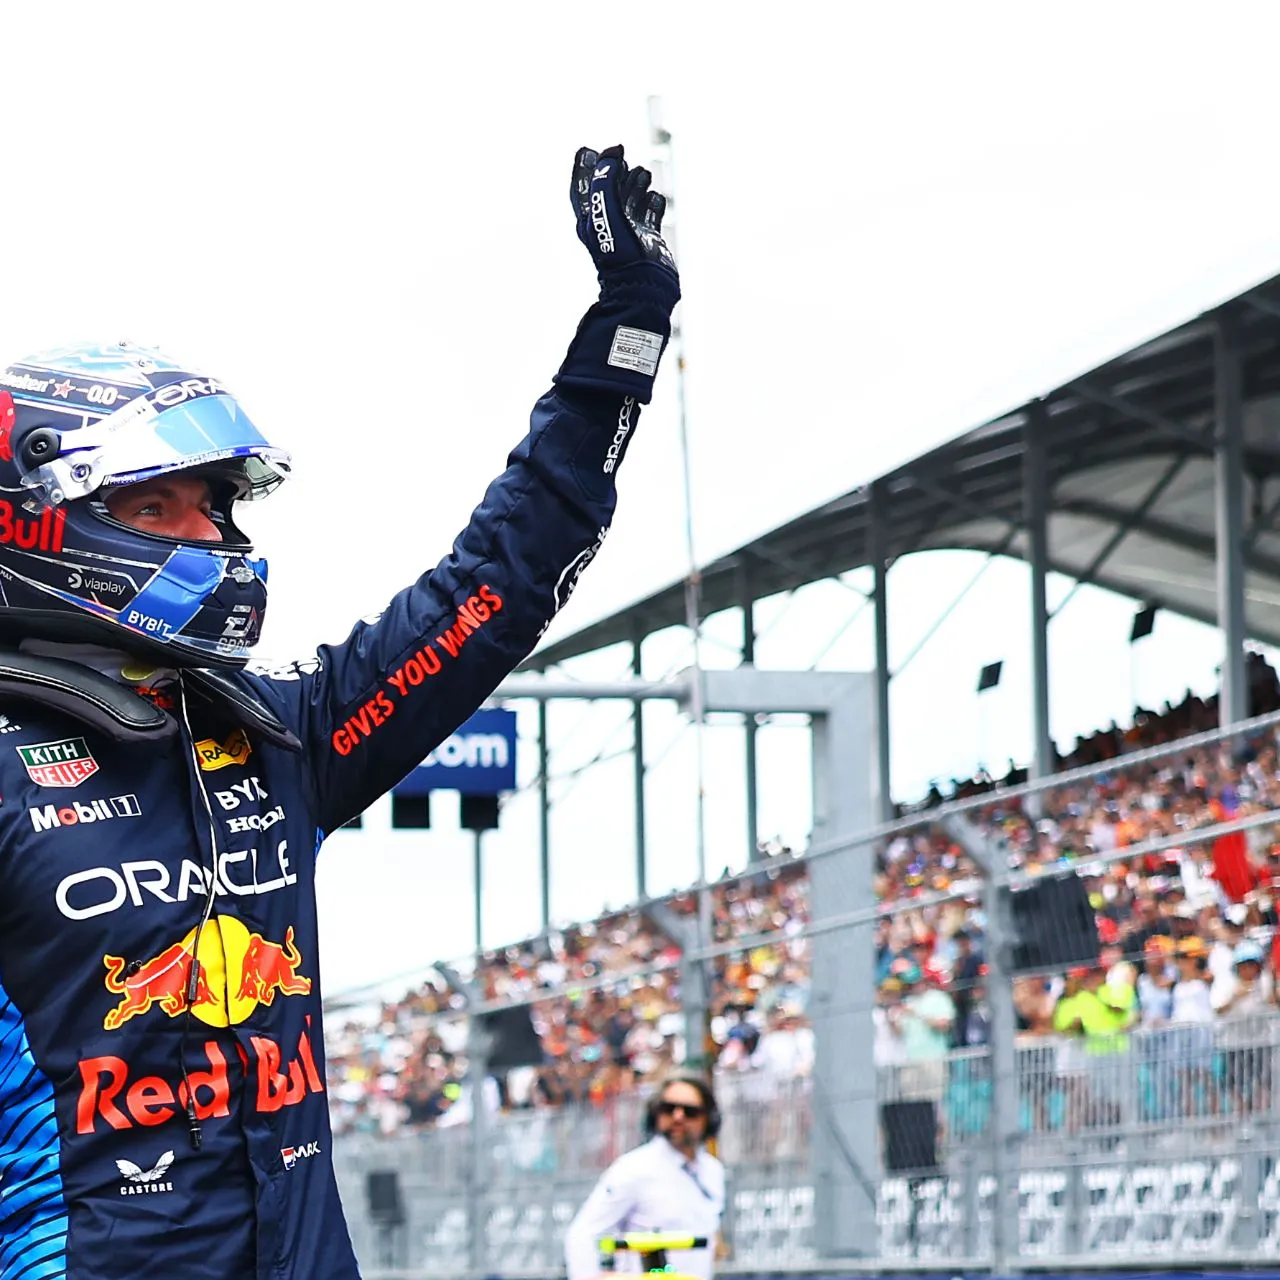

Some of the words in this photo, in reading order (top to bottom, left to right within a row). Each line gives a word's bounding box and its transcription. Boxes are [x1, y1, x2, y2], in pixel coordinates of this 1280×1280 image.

[591, 190, 615, 254] sparco
[153, 377, 226, 406] ORA
[0, 569, 15, 582] MAX
[83, 579, 126, 596] viaplay
[127, 610, 172, 638] BYBIT
[332, 690, 396, 757] GIVES
[387, 648, 444, 698] YOU
[435, 584, 504, 659] WINGS
[27, 741, 80, 767] KITH
[32, 757, 97, 786] HEUER
[30, 797, 112, 833] Mobil
[226, 805, 286, 834] HODA
[55, 839, 298, 921] ORACLE
[76, 1040, 240, 1135] Red
[250, 1014, 324, 1113] Bul
[120, 1181, 174, 1196] CASTORE
